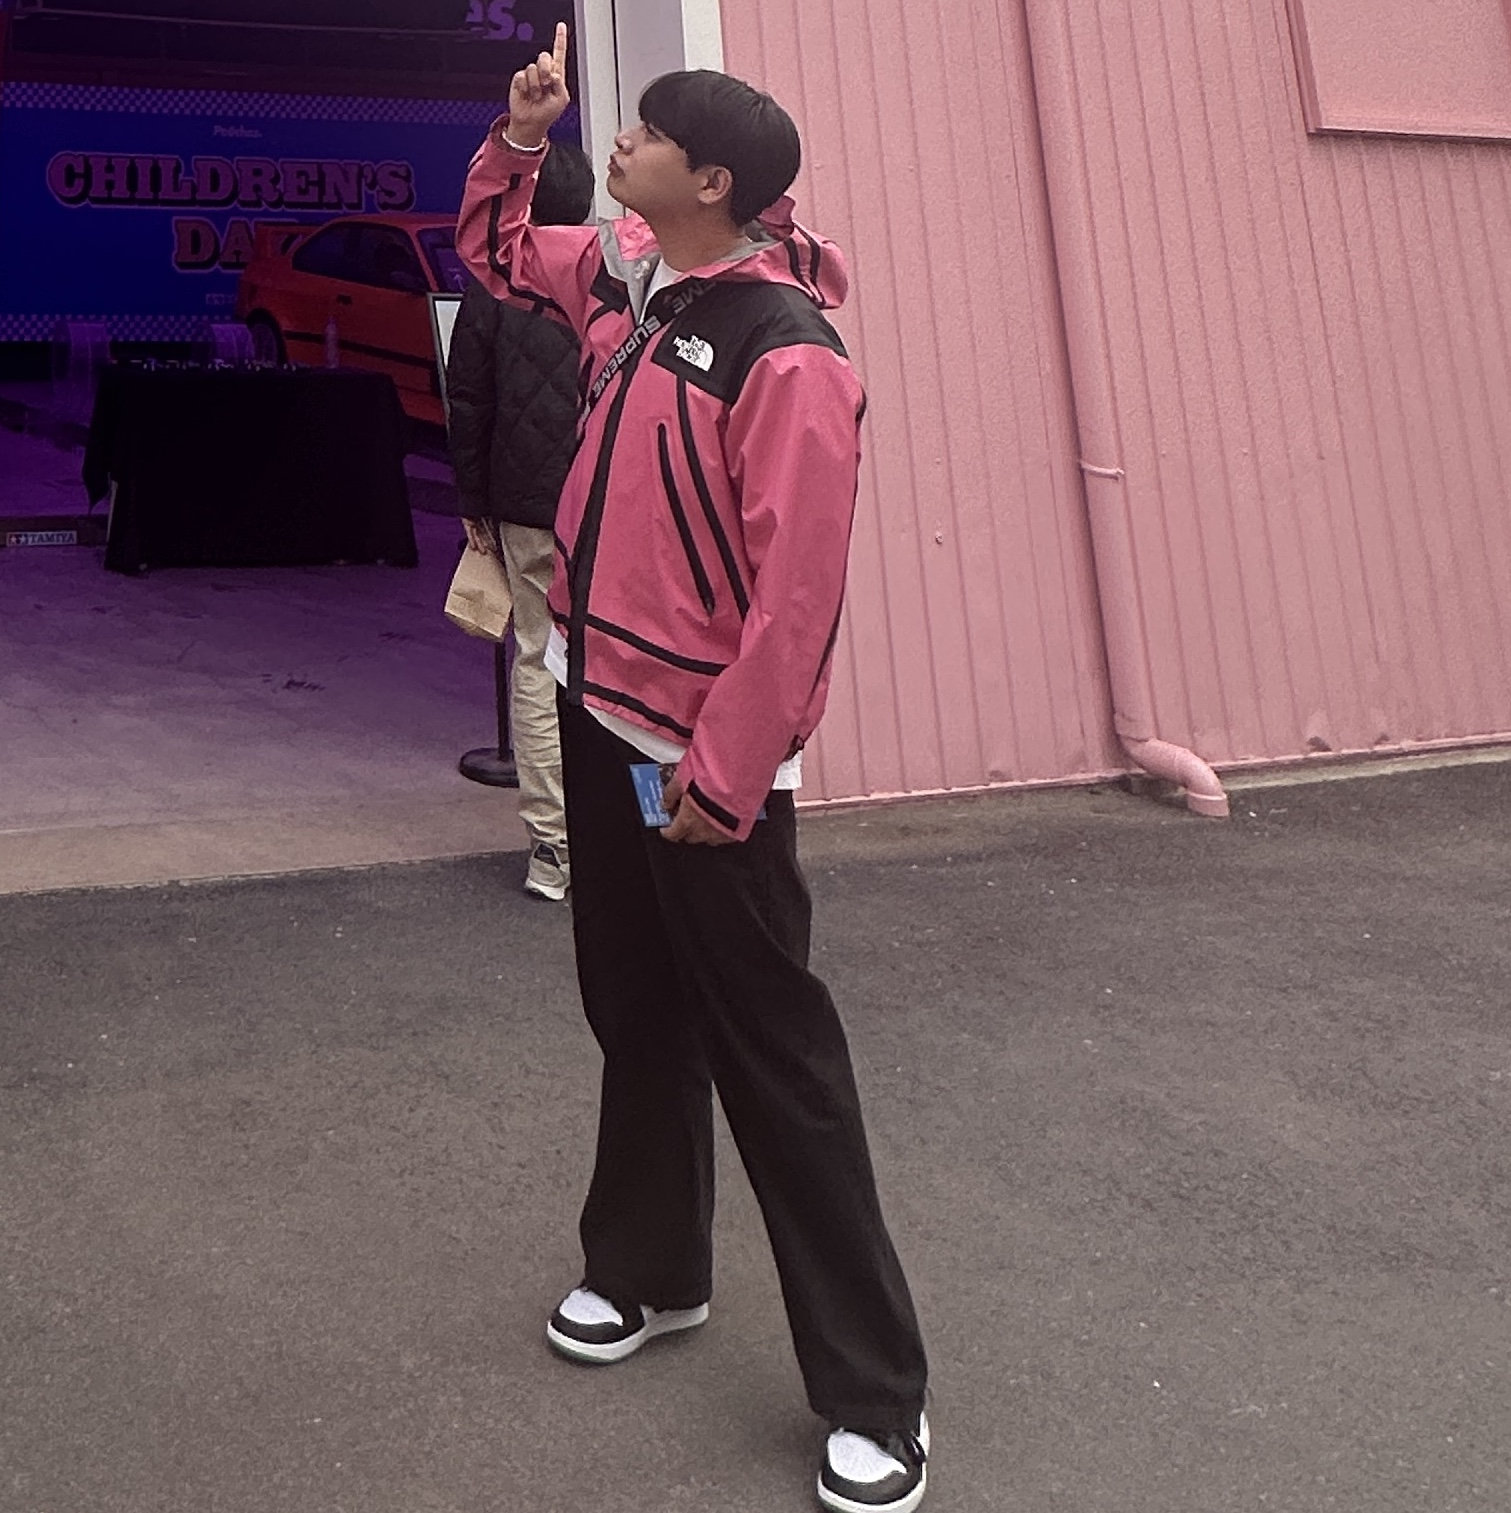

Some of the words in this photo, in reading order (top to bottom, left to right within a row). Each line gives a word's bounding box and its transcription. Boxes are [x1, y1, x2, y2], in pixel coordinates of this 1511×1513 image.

[47, 151, 416, 213] CHILDREN'S
[591, 314, 662, 399] SUPREME
[29, 532, 76, 545] TAMIYA
